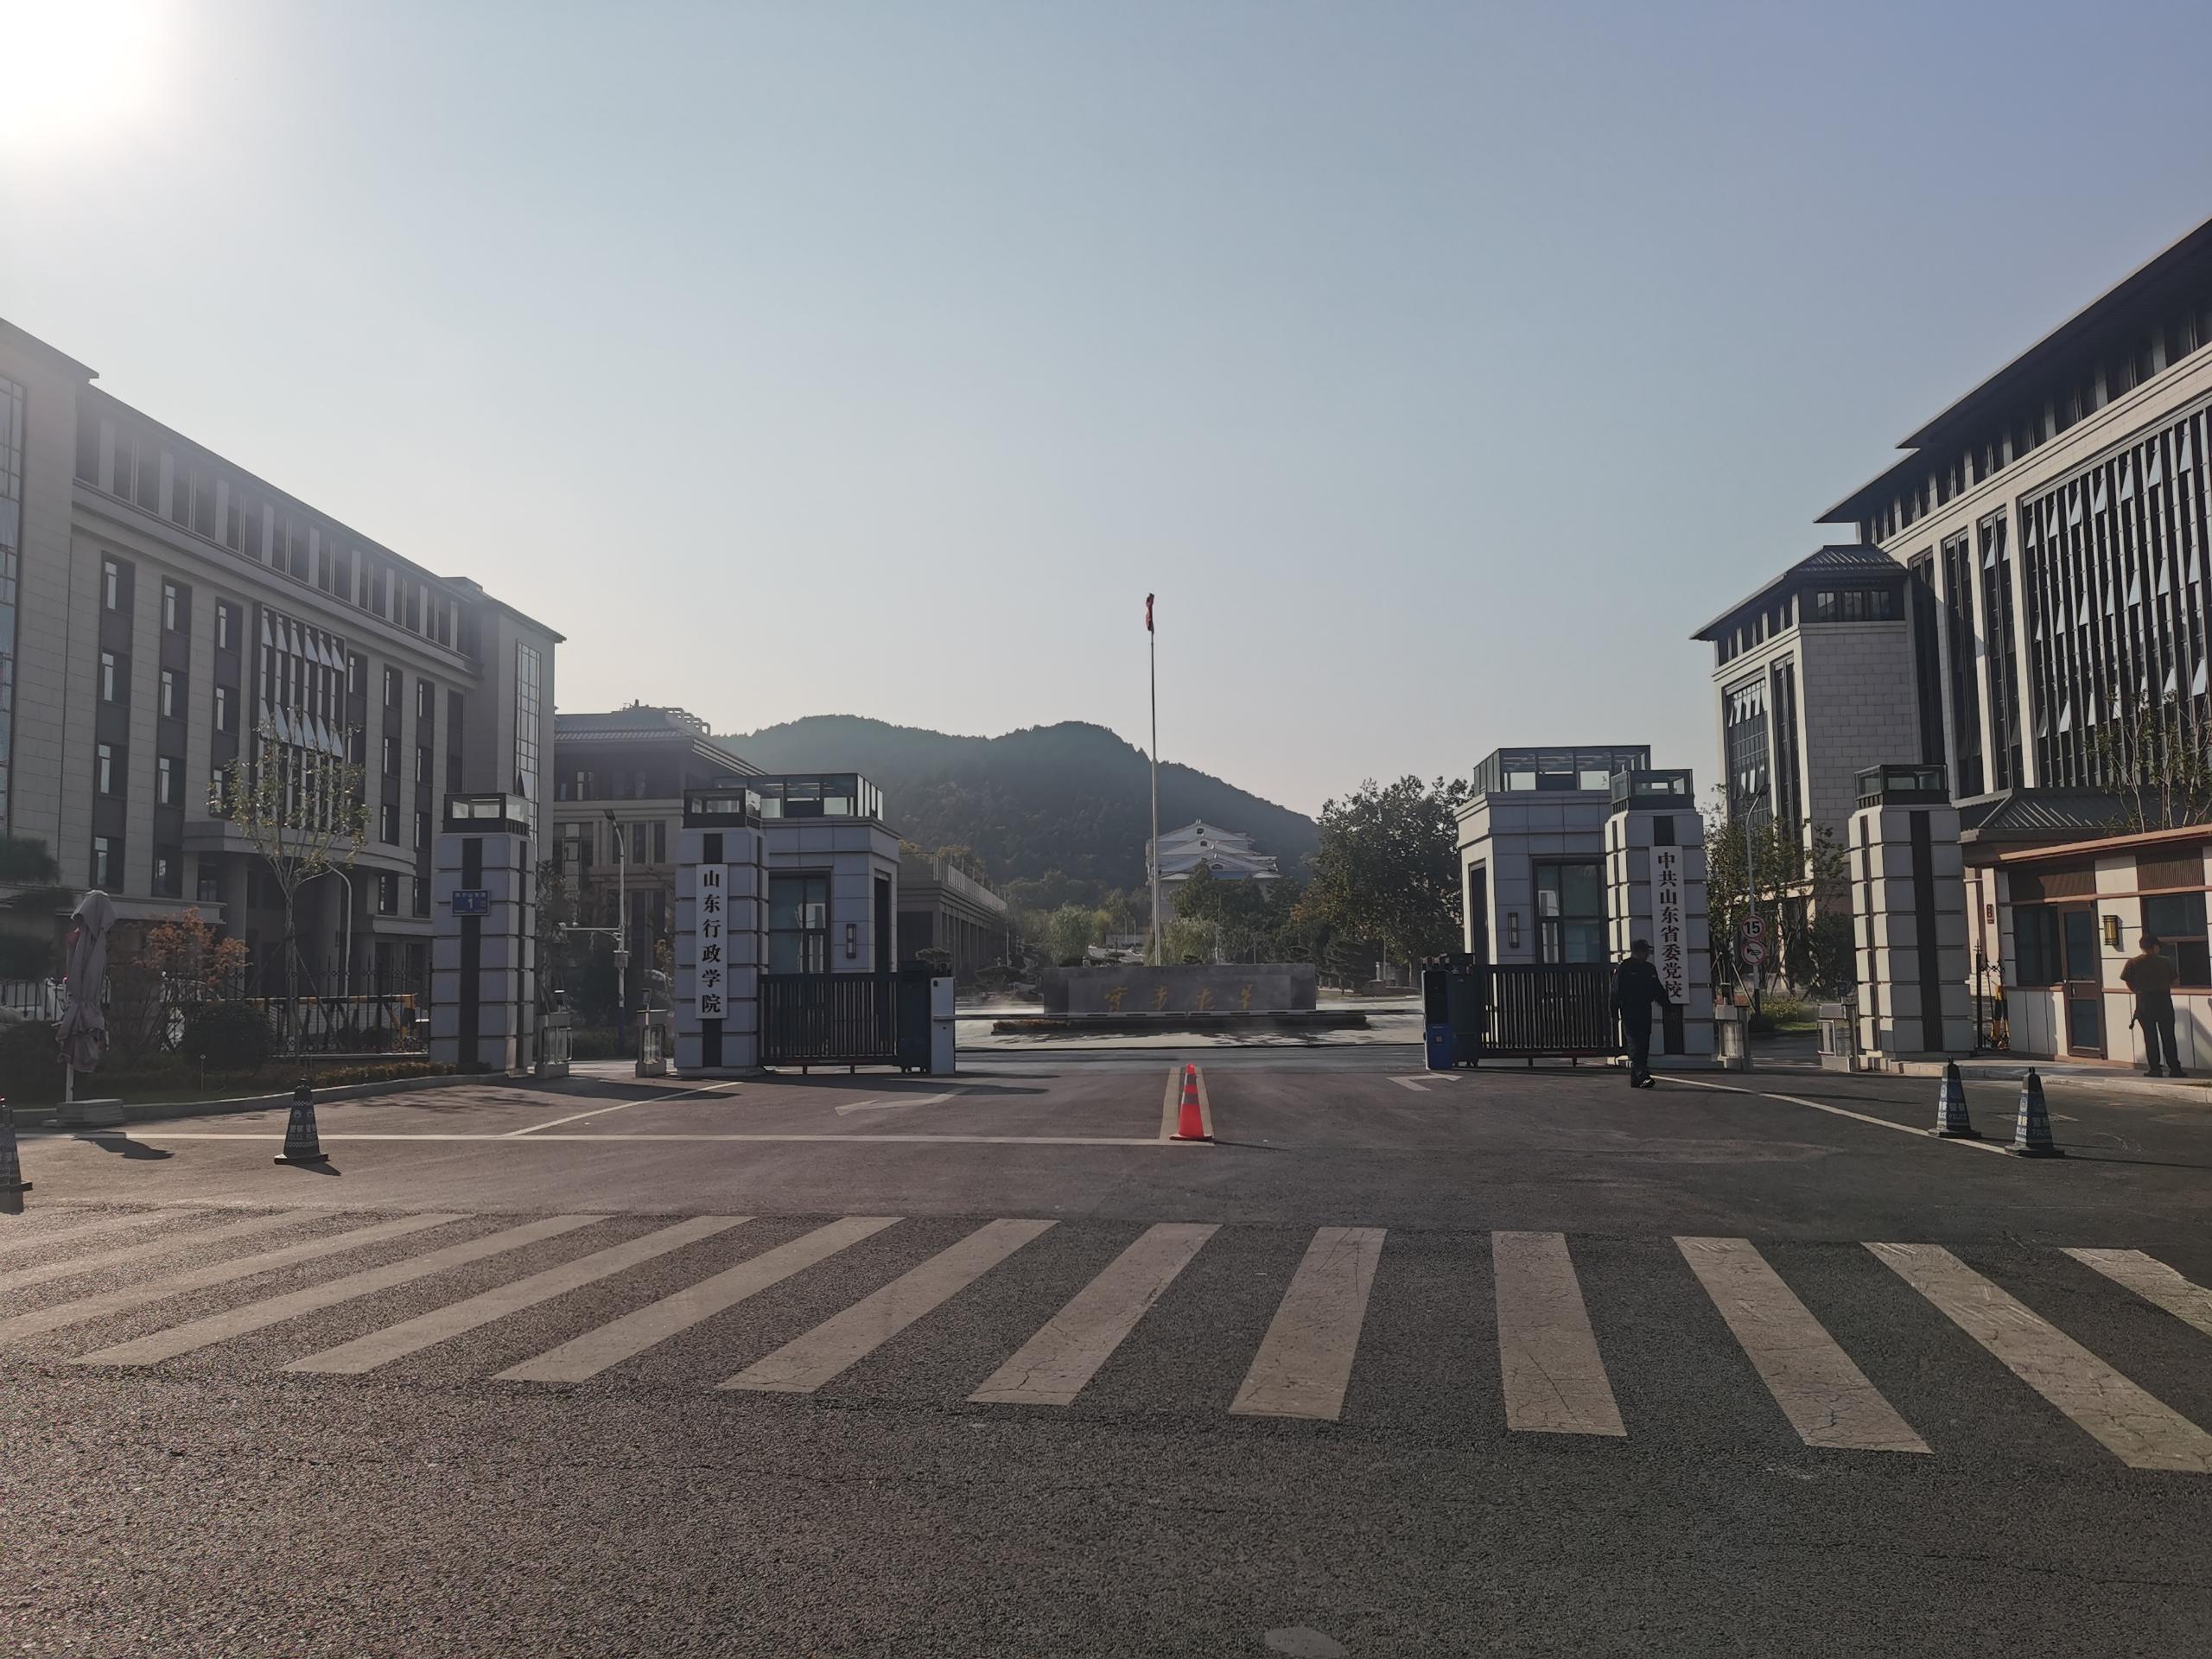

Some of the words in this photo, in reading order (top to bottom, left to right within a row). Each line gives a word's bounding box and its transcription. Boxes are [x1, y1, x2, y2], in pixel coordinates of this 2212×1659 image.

[467, 898, 474, 909] 1
[701, 869, 721, 1014] 山东行政学院
[1657, 851, 1682, 999] 中共山东省委党校
[1744, 921, 1760, 935] 15
